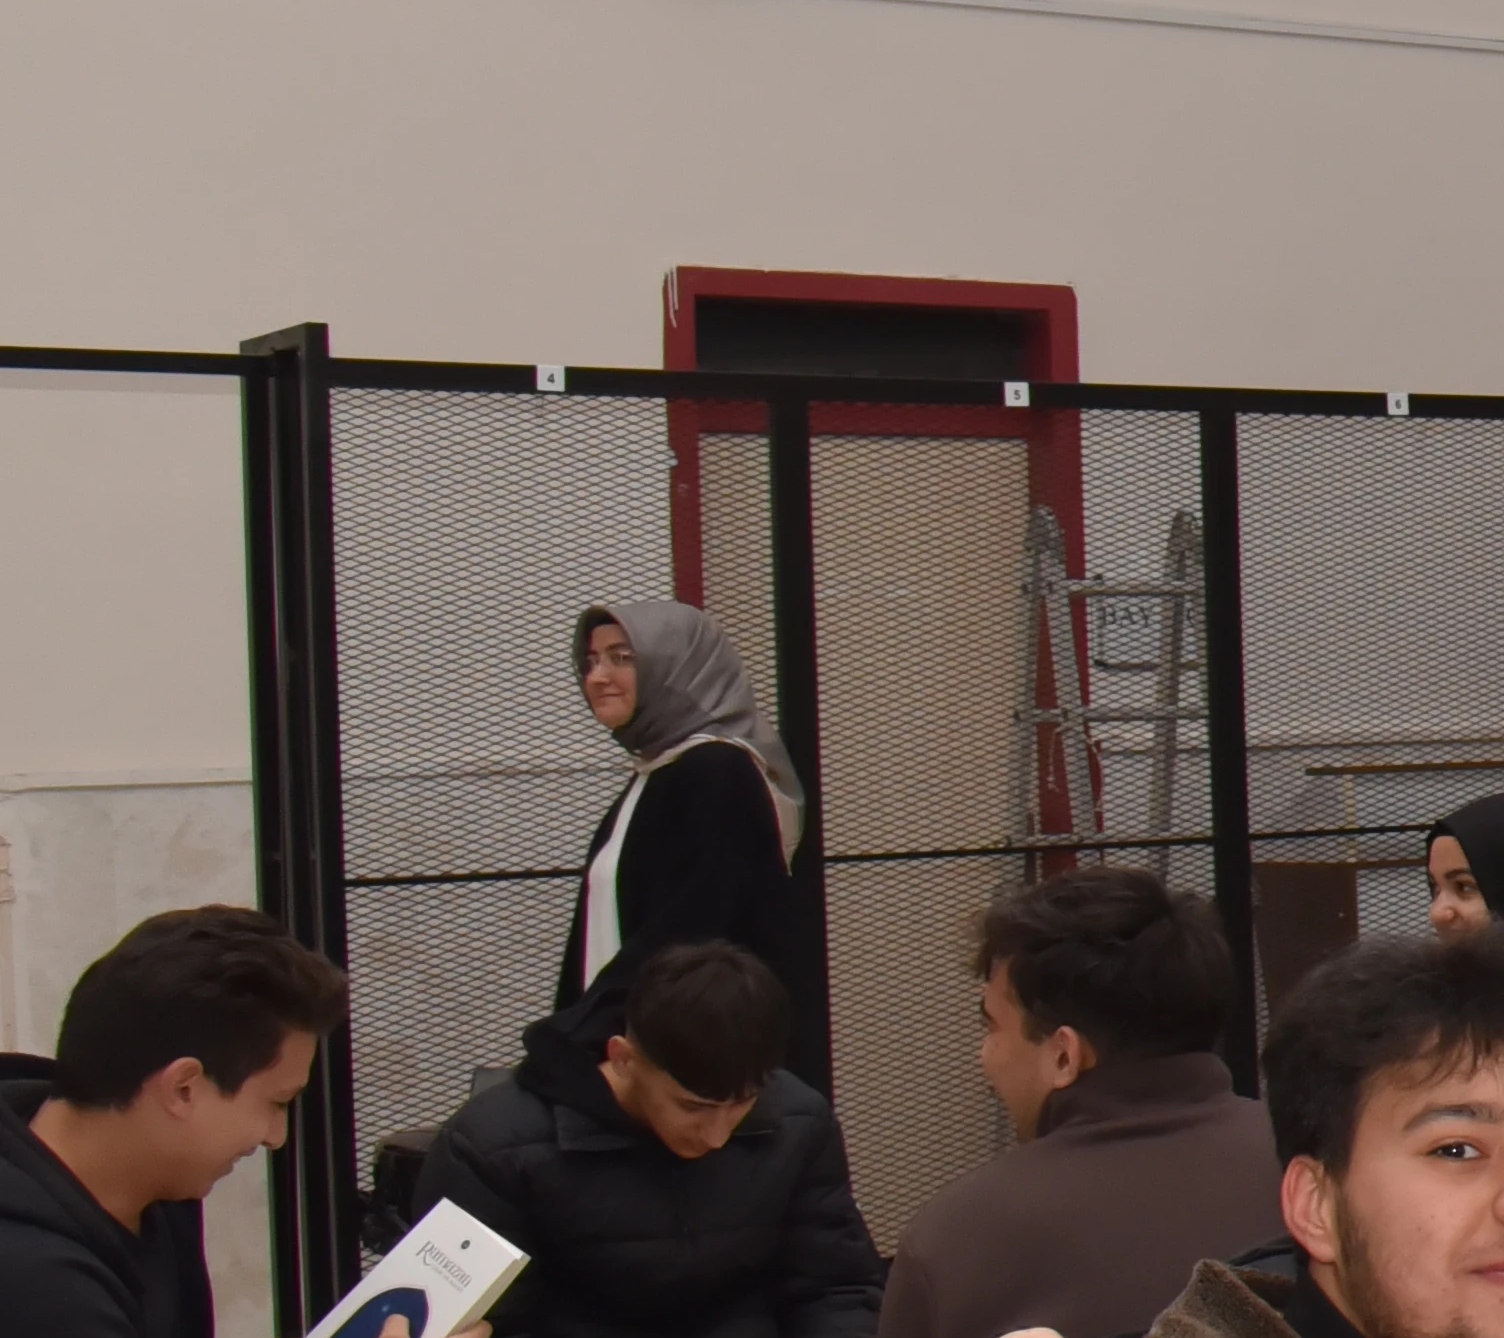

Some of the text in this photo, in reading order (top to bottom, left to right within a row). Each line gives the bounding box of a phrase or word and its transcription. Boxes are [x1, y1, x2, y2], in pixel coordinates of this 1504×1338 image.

[547, 372, 555, 384] 4
[1013, 389, 1021, 401] 5
[1394, 398, 1402, 410] 6
[415, 1240, 473, 1289] Ramazan
